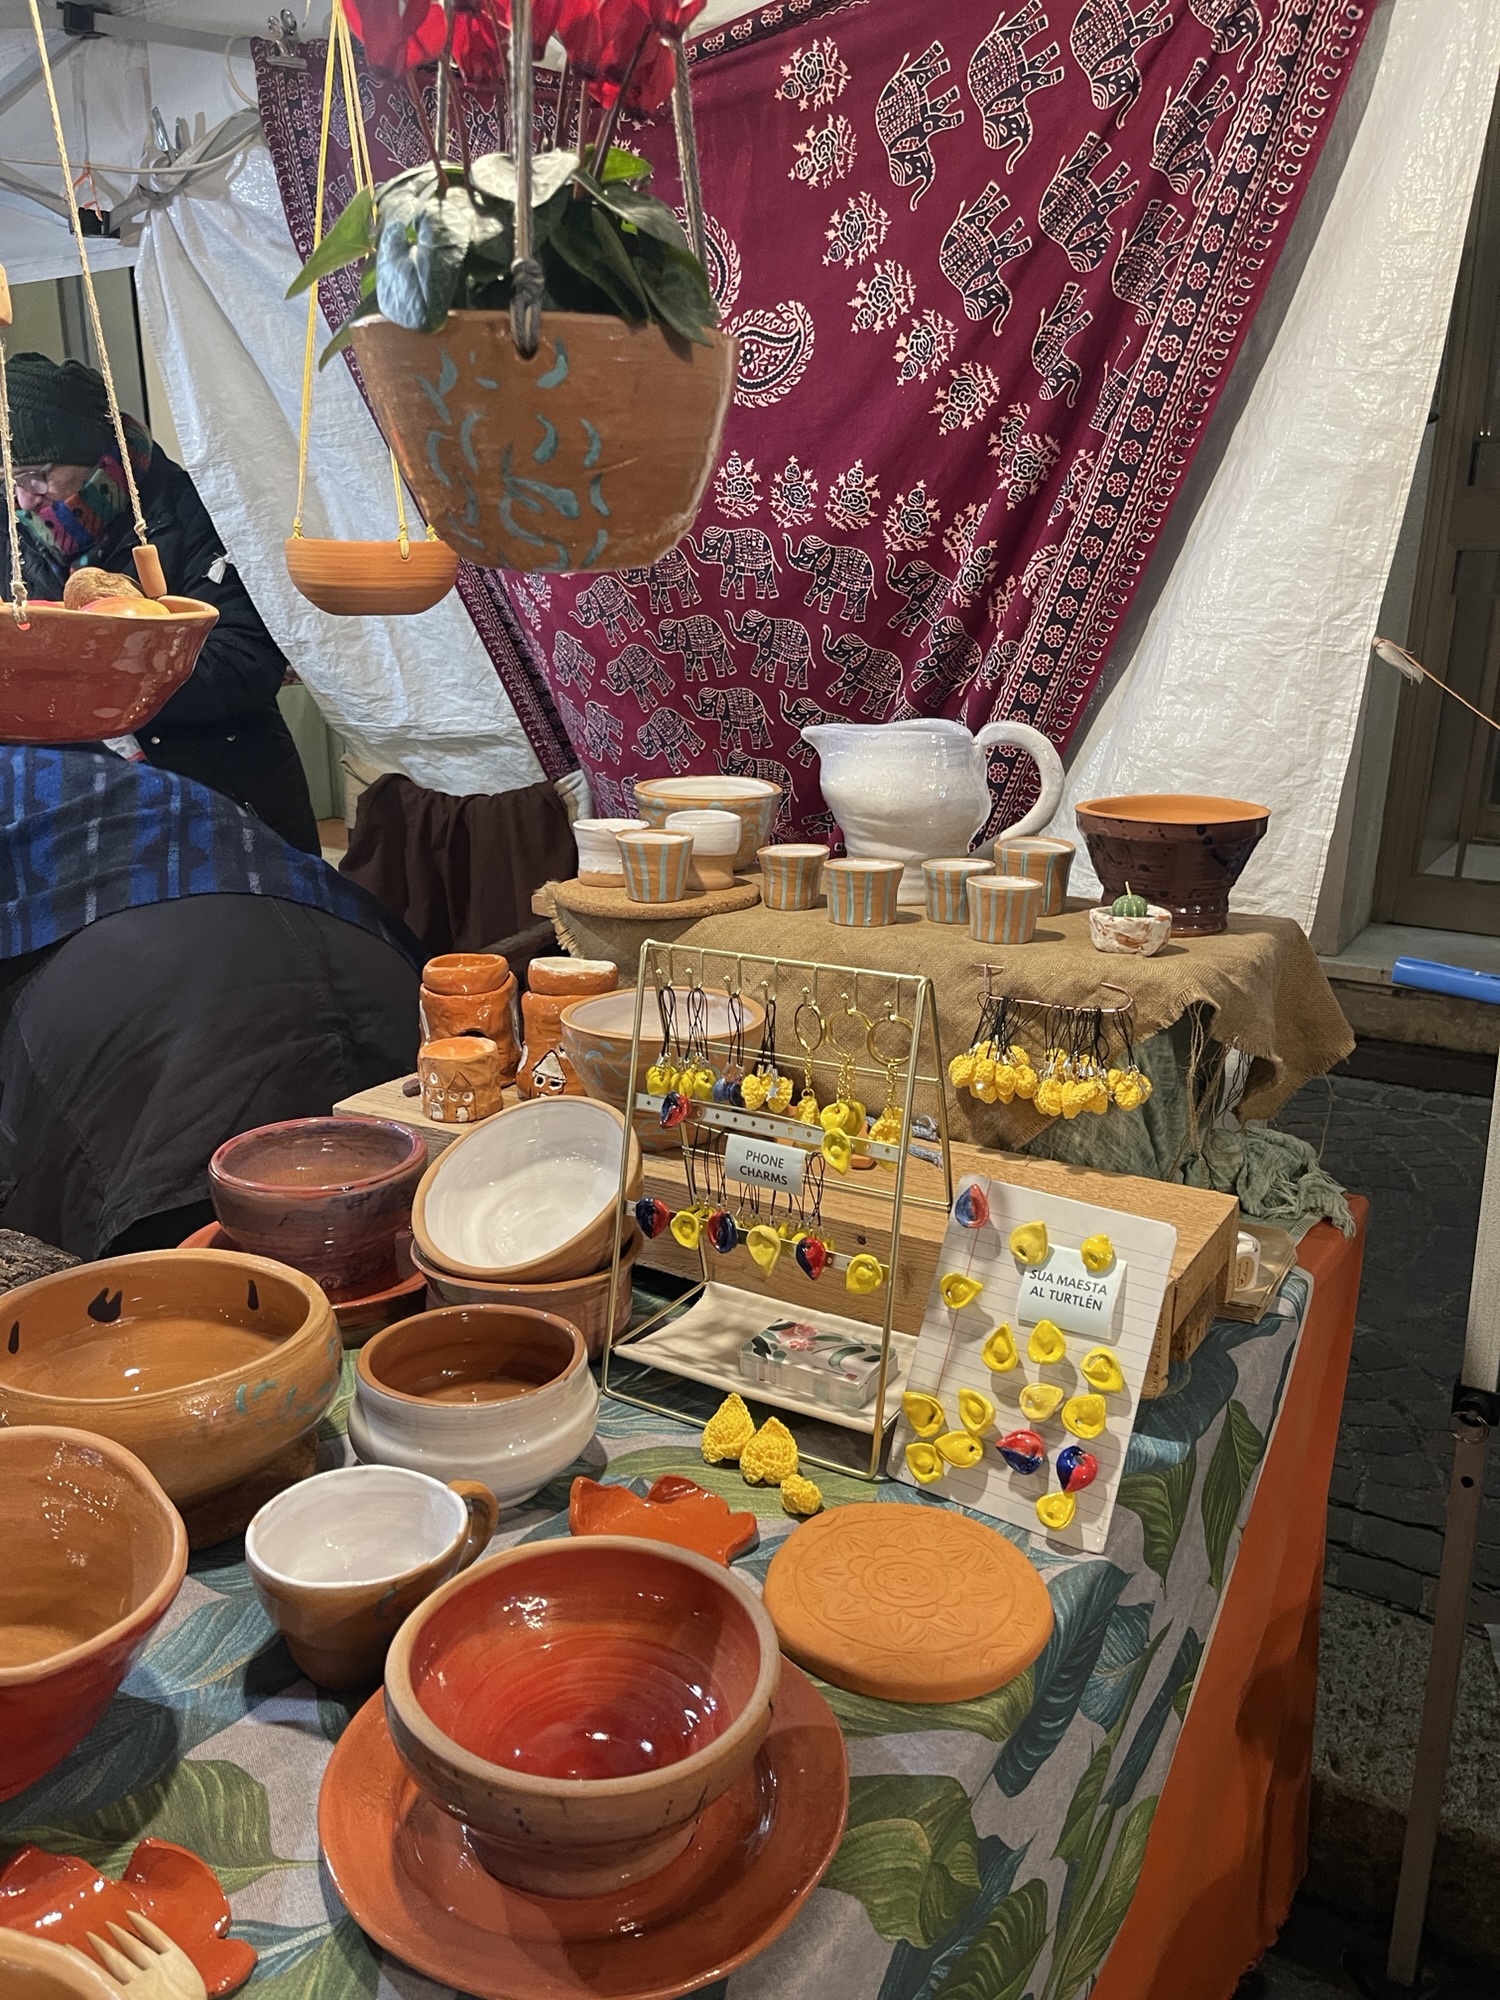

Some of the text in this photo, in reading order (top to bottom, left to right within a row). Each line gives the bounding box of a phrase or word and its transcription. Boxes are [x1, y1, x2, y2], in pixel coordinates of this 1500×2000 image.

[745, 1149, 785, 1169] PHONE
[739, 1165, 788, 1186] CHARMS
[1029, 1269, 1107, 1296] SUA MAESTA
[1029, 1286, 1103, 1311] AL TURTLÉN
